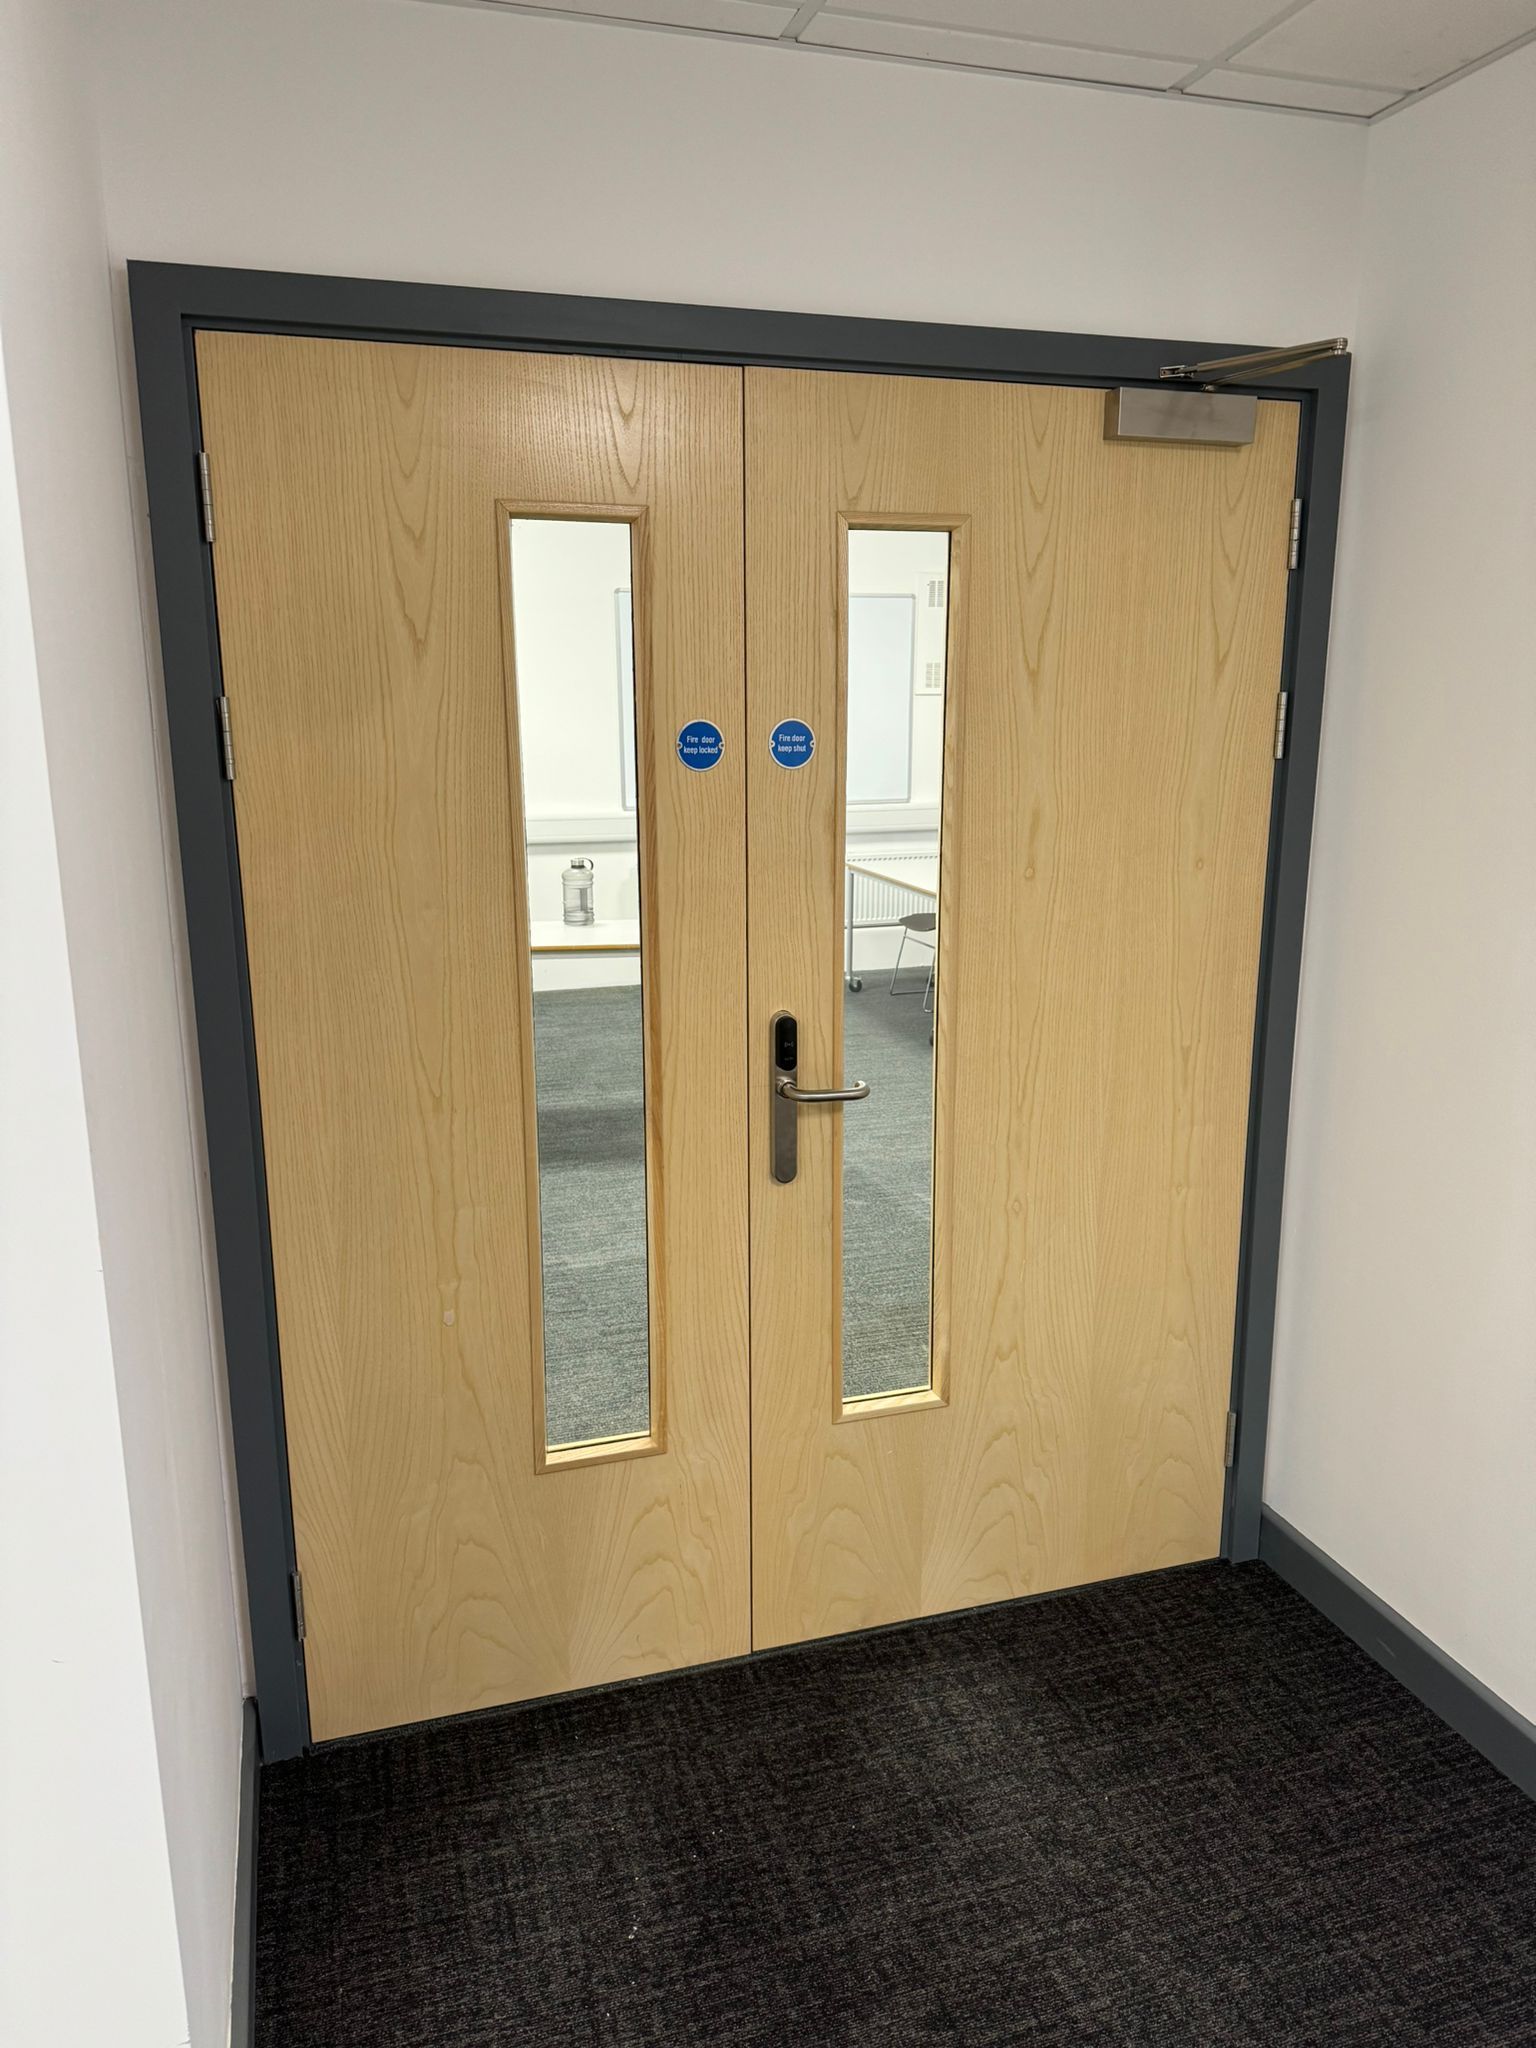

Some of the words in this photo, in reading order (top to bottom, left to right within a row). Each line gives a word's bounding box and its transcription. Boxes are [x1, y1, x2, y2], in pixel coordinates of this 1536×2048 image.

[686, 735, 699, 744] Fire
[701, 735, 715, 744] door
[778, 734, 791, 742] Fire
[792, 734, 806, 742] door
[683, 746, 697, 755] keep
[698, 746, 718, 754] locked
[777, 744, 792, 753] keep
[793, 744, 807, 752] shut
